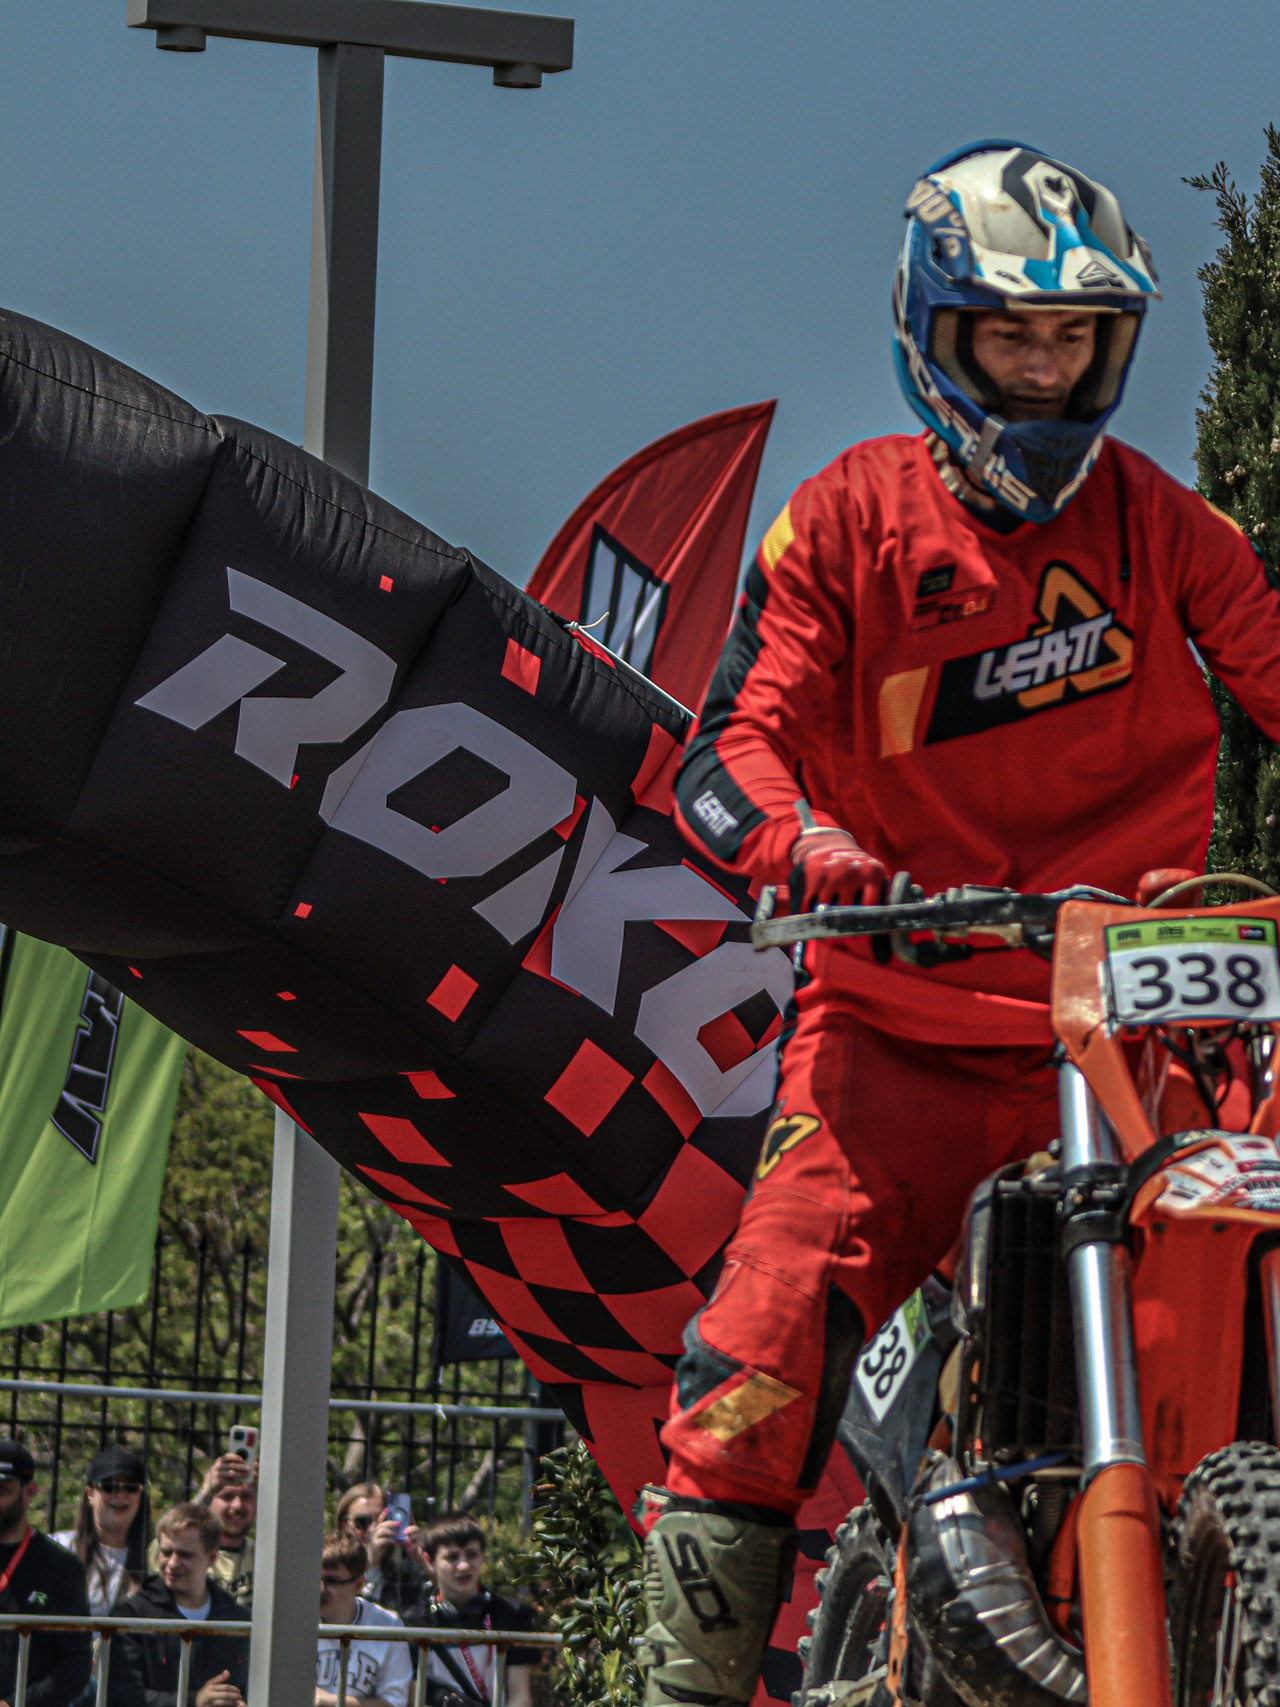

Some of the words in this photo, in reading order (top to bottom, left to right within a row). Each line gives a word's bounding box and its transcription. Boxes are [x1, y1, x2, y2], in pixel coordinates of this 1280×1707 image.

[973, 611, 1113, 699] LEATT
[692, 790, 739, 837] LEATT
[1130, 951, 1266, 1011] 338
